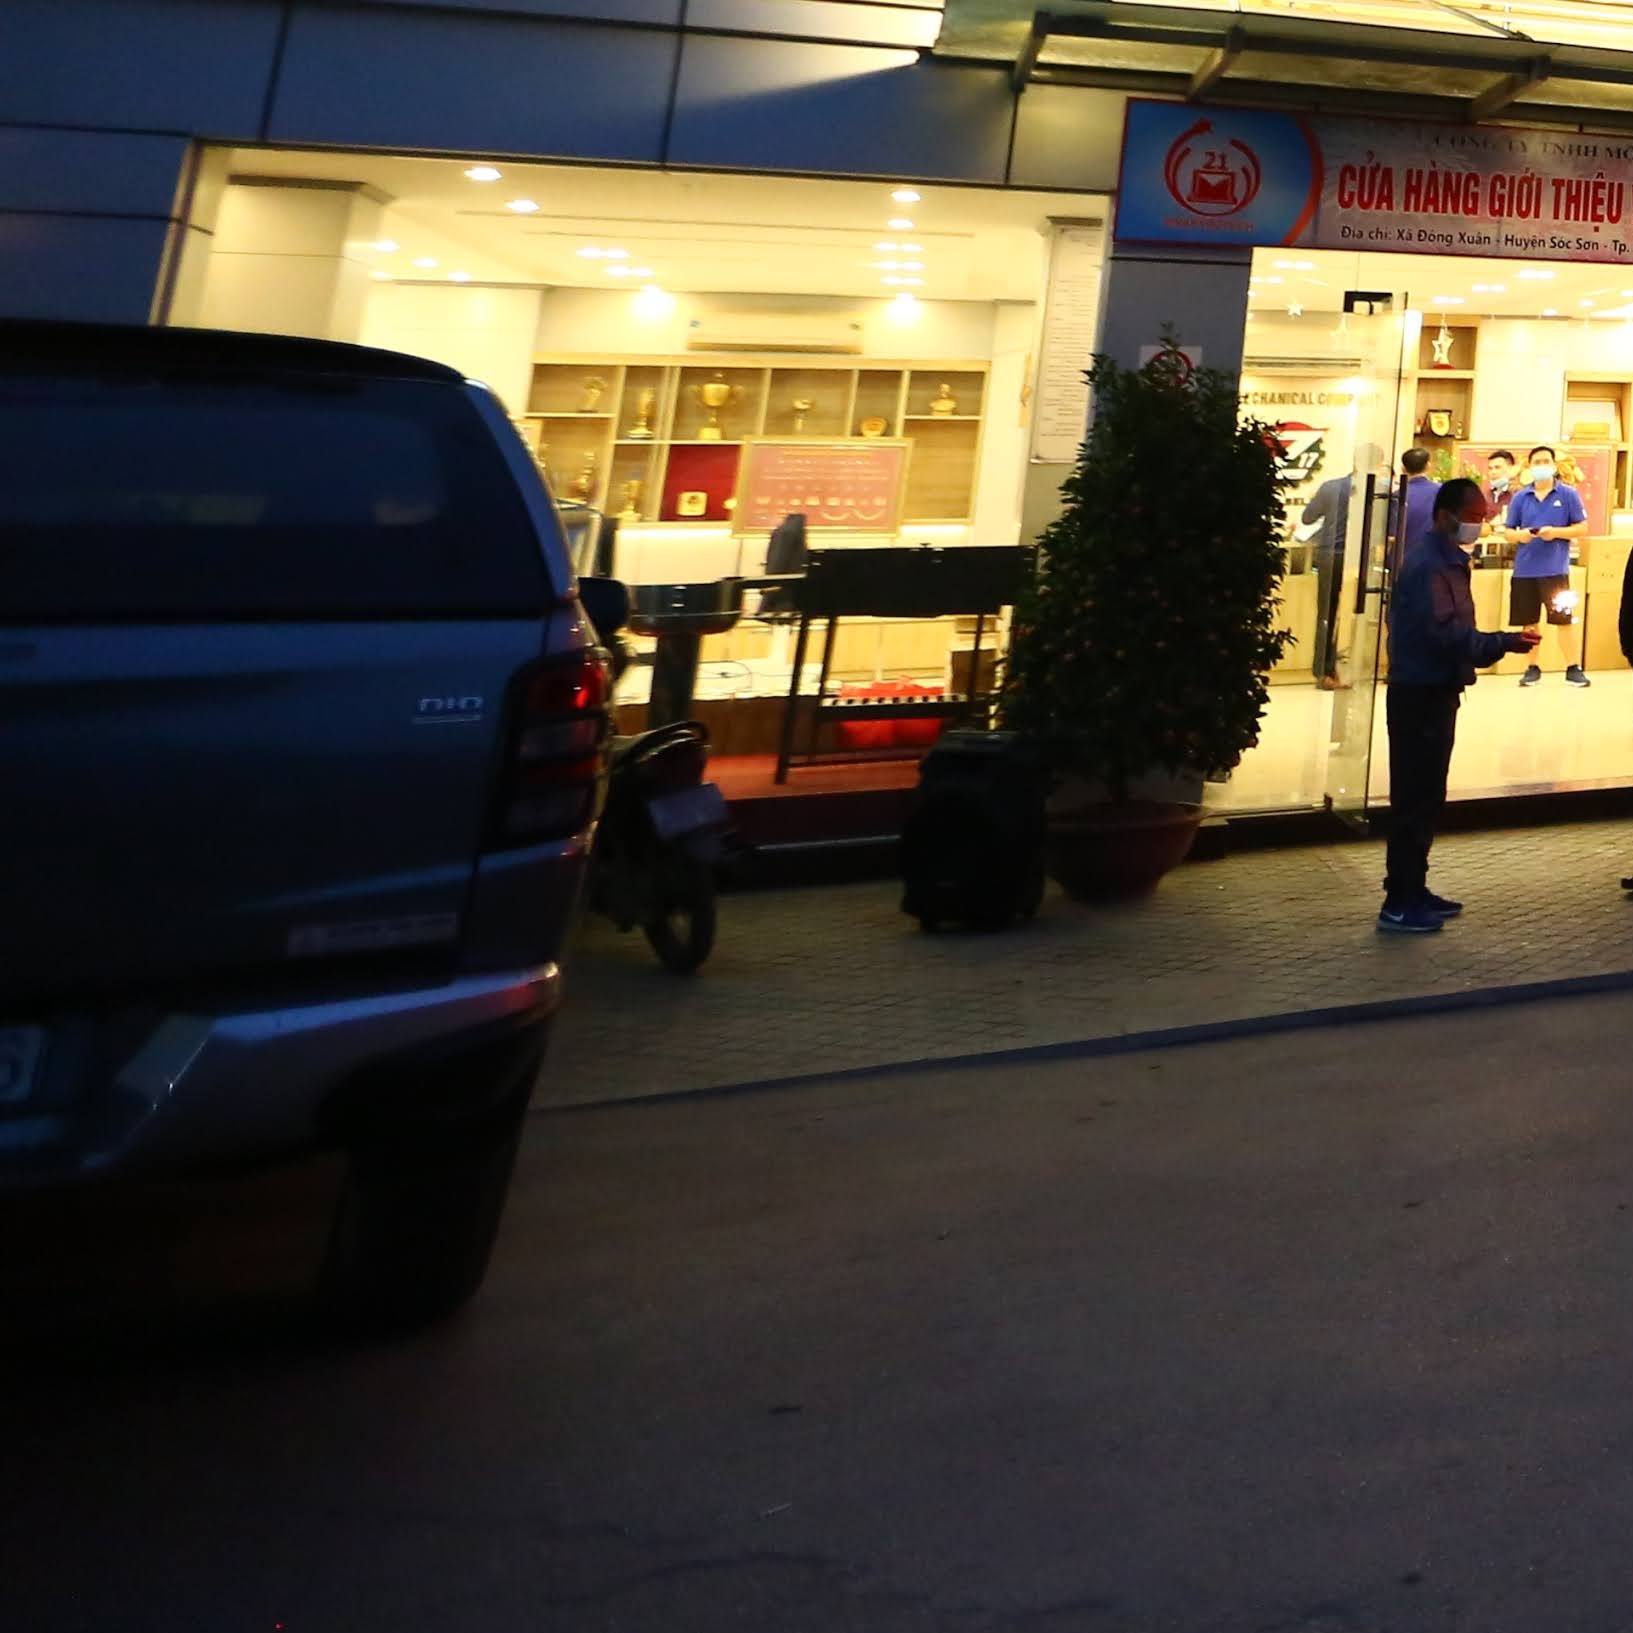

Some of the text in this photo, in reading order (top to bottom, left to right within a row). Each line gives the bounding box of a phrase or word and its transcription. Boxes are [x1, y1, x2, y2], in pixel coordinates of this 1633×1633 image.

[1336, 150, 1394, 212] CỬA
[1403, 160, 1481, 217] HÀNG
[1488, 167, 1542, 221] GIỚI
[1551, 172, 1624, 233] THIỆU
[1612, 240, 1631, 255] Tp.
